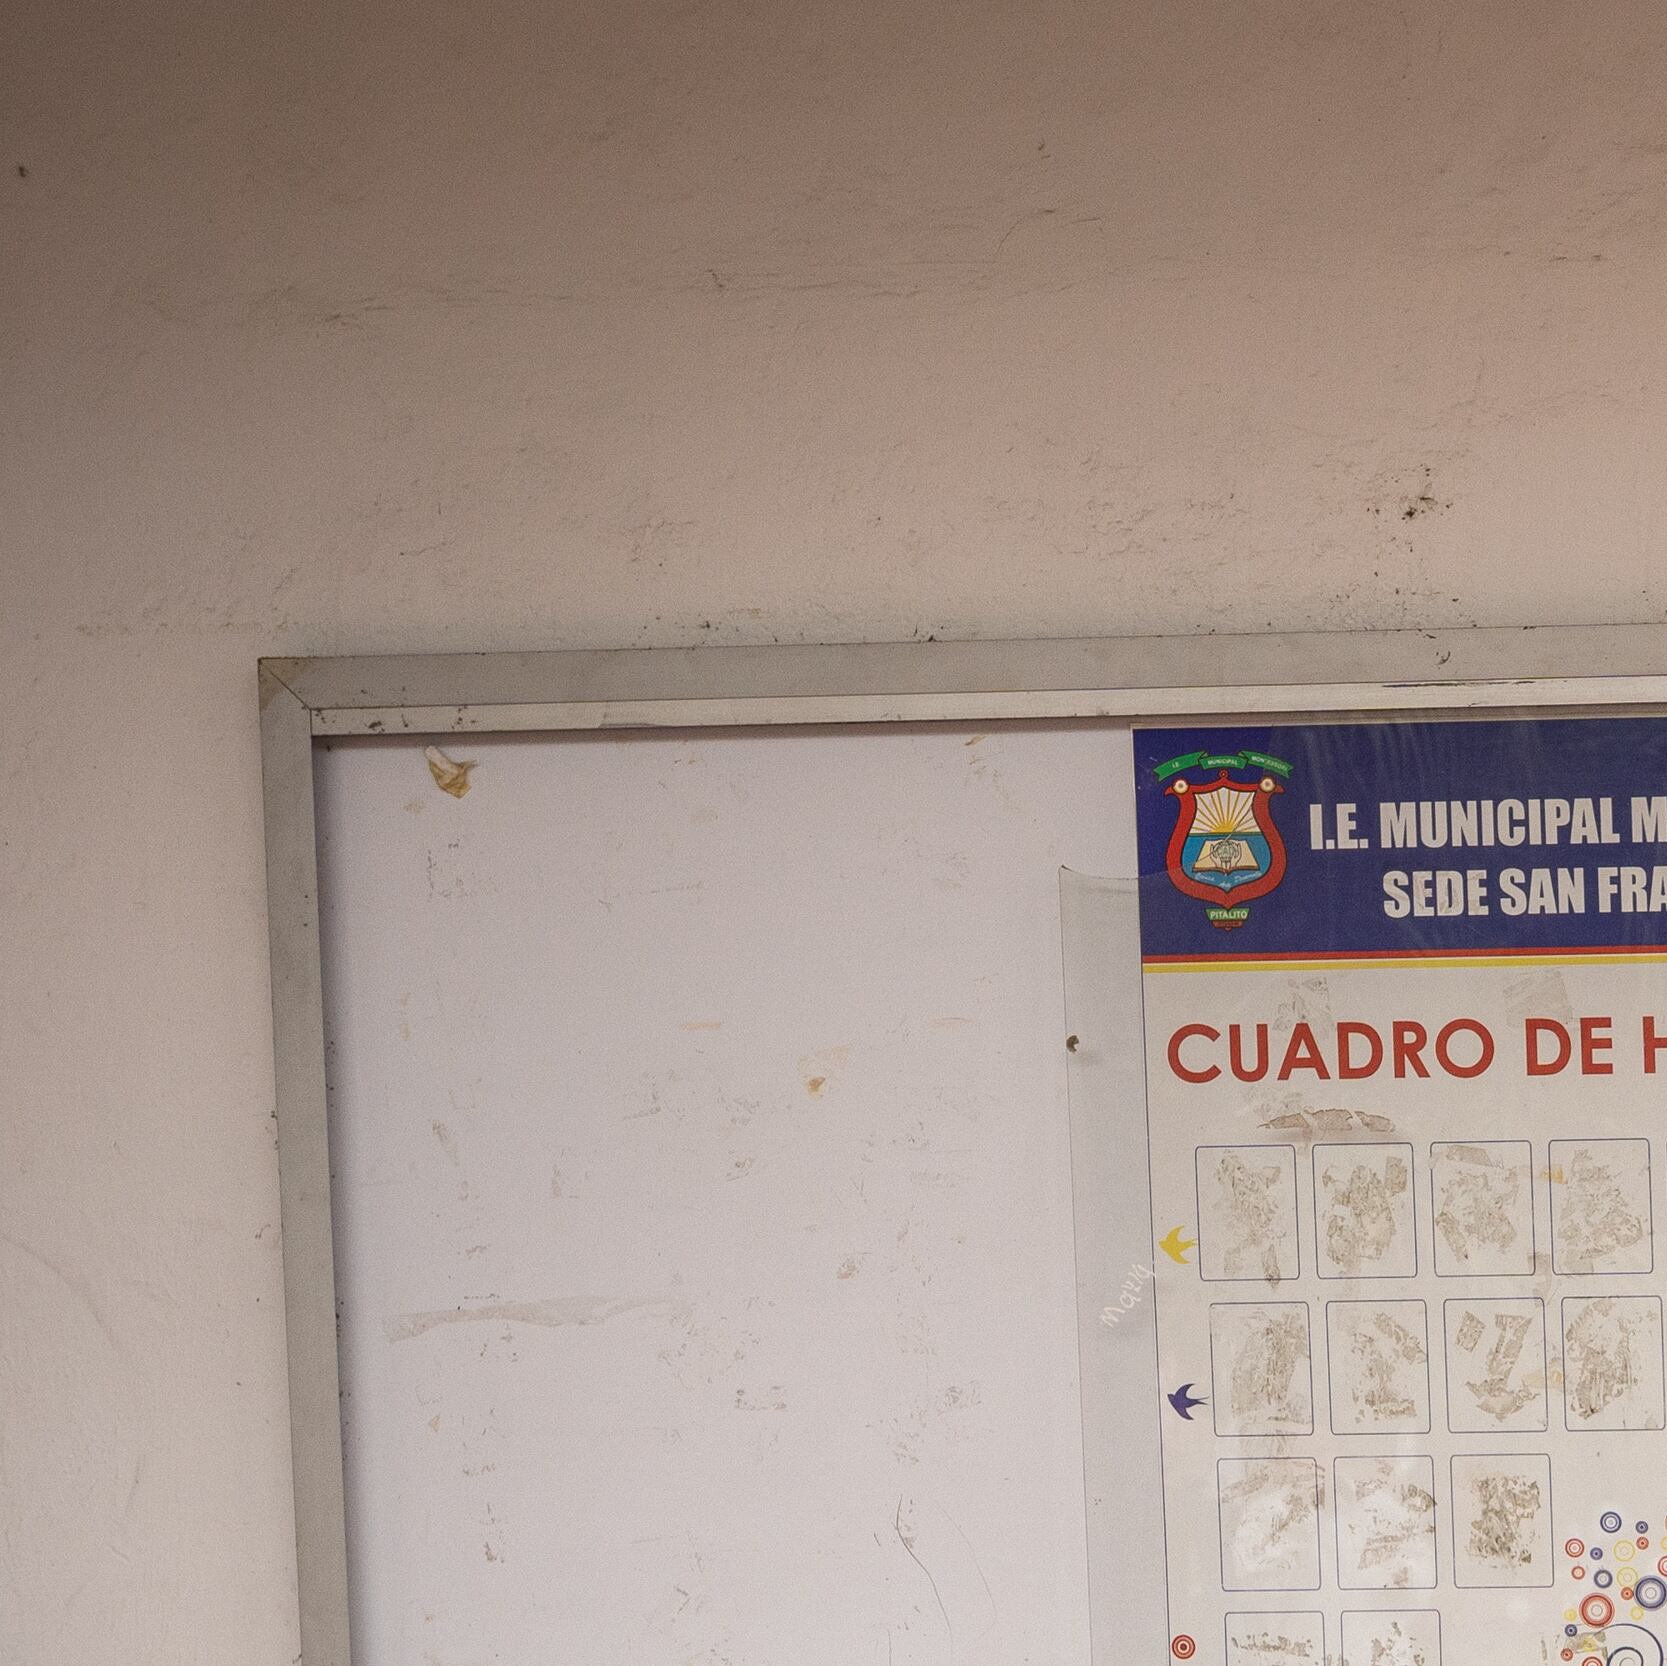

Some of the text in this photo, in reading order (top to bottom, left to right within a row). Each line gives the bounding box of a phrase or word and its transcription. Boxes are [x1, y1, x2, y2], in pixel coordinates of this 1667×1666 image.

[1309, 803, 1369, 850] I.E.
[1379, 797, 1620, 849] MUNICIPAL
[1209, 910, 1248, 920] PITALITO
[1382, 869, 1489, 919] SEDE
[1499, 867, 1585, 916] SAN
[1167, 1018, 1495, 1084] CUADRO
[1525, 1017, 1614, 1076] DE
